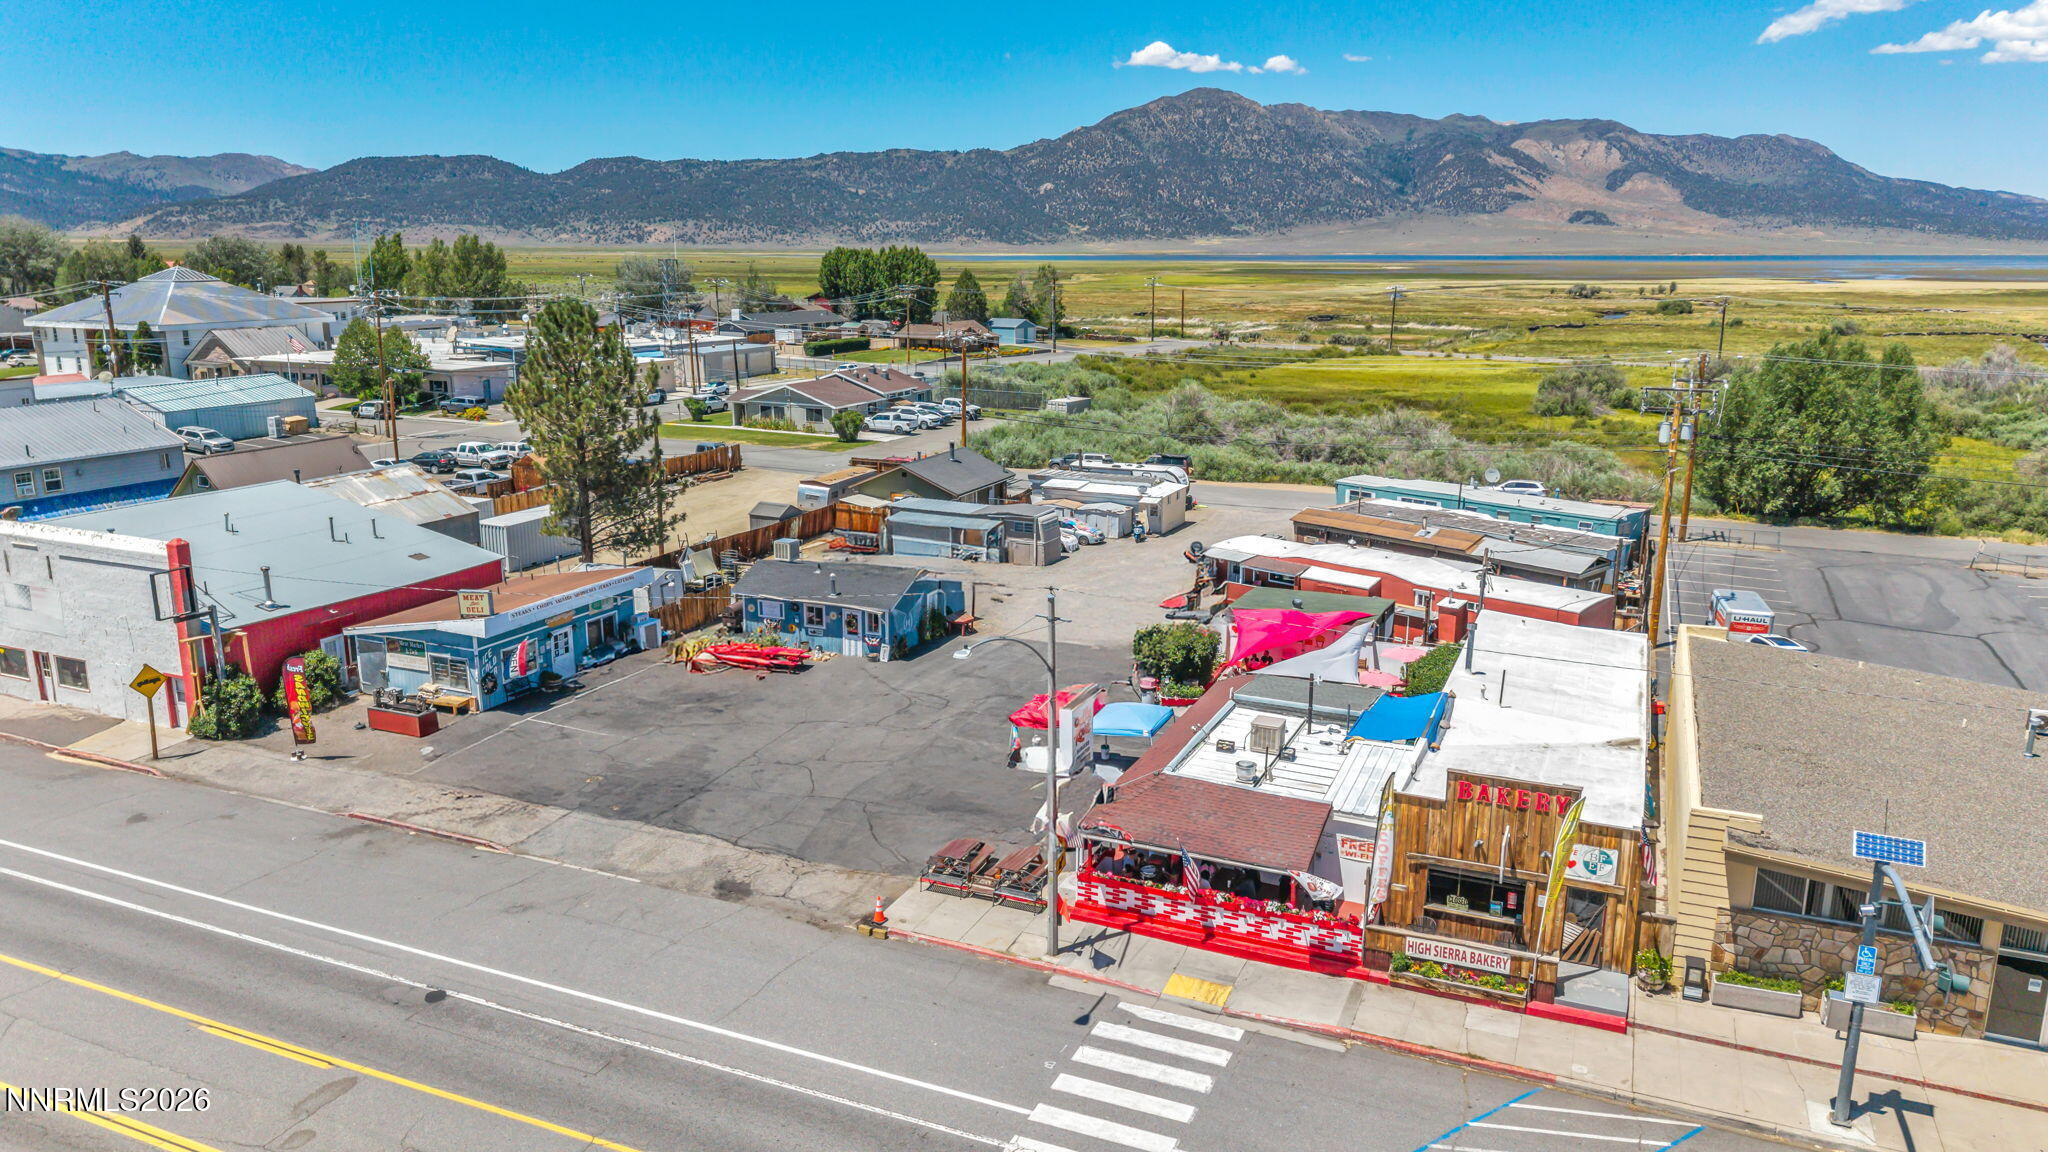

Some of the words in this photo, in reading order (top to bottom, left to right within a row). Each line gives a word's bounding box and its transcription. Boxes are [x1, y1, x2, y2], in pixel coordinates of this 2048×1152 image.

[1733, 616, 1768, 624] U-HAUL
[482, 648, 493, 665] ICE
[1457, 780, 1573, 815] BAKERY
[1340, 837, 1375, 853] FREE
[1376, 832, 1390, 899] COFFEE
[1407, 940, 1432, 956] HIGH
[1433, 945, 1468, 963] SIERRA
[1469, 951, 1510, 970] BAKERY
